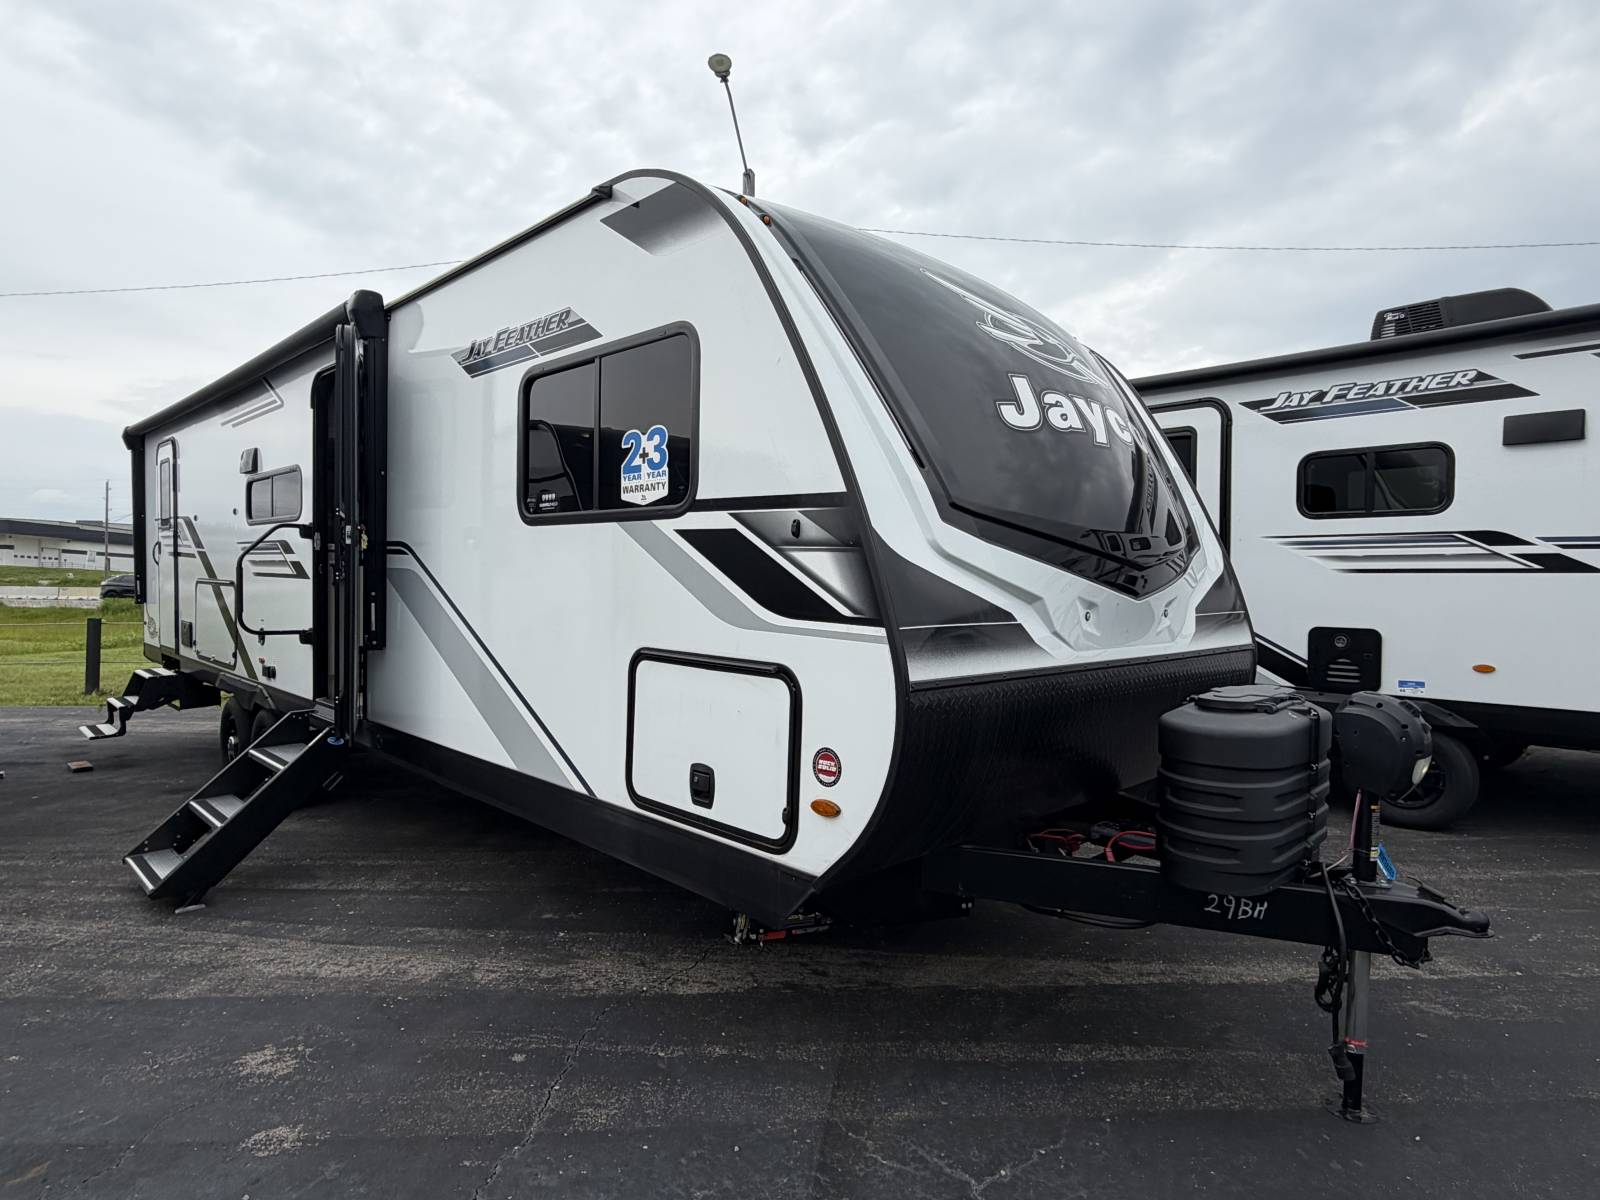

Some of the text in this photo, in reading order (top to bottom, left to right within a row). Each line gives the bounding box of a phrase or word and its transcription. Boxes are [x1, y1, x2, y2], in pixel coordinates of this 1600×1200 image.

[461, 307, 572, 362] JAY FEATHER
[1259, 369, 1479, 411] JAY FEATHER
[622, 469, 667, 483] YEAR YEAR
[622, 481, 667, 495] WARRANTY
[1203, 894, 1268, 920] 29BH
